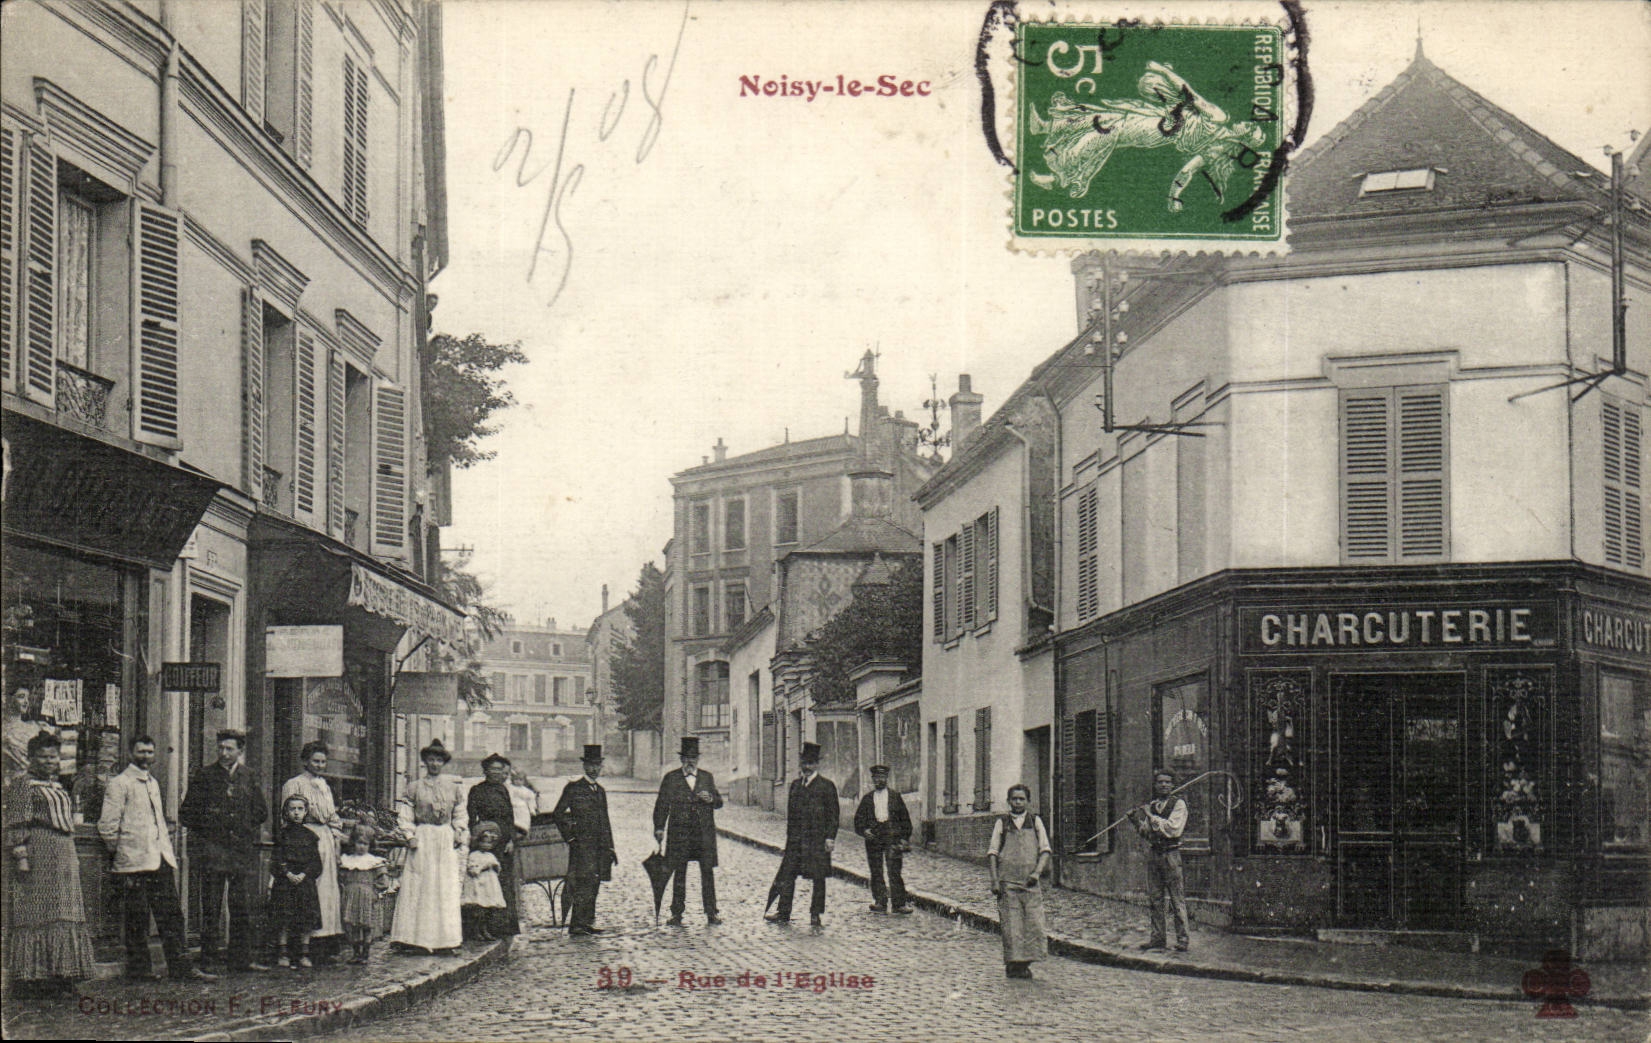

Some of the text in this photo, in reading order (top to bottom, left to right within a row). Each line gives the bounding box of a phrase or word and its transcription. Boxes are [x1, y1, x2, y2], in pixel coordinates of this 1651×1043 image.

[1251, 34, 1273, 121] REPUBLIQU
[1252, 150, 1272, 232] FRANAISE
[1032, 208, 1118, 229] POSTES
[1261, 608, 1532, 646] CHARCUTERIE
[1584, 611, 1651, 654] CHARCUT
